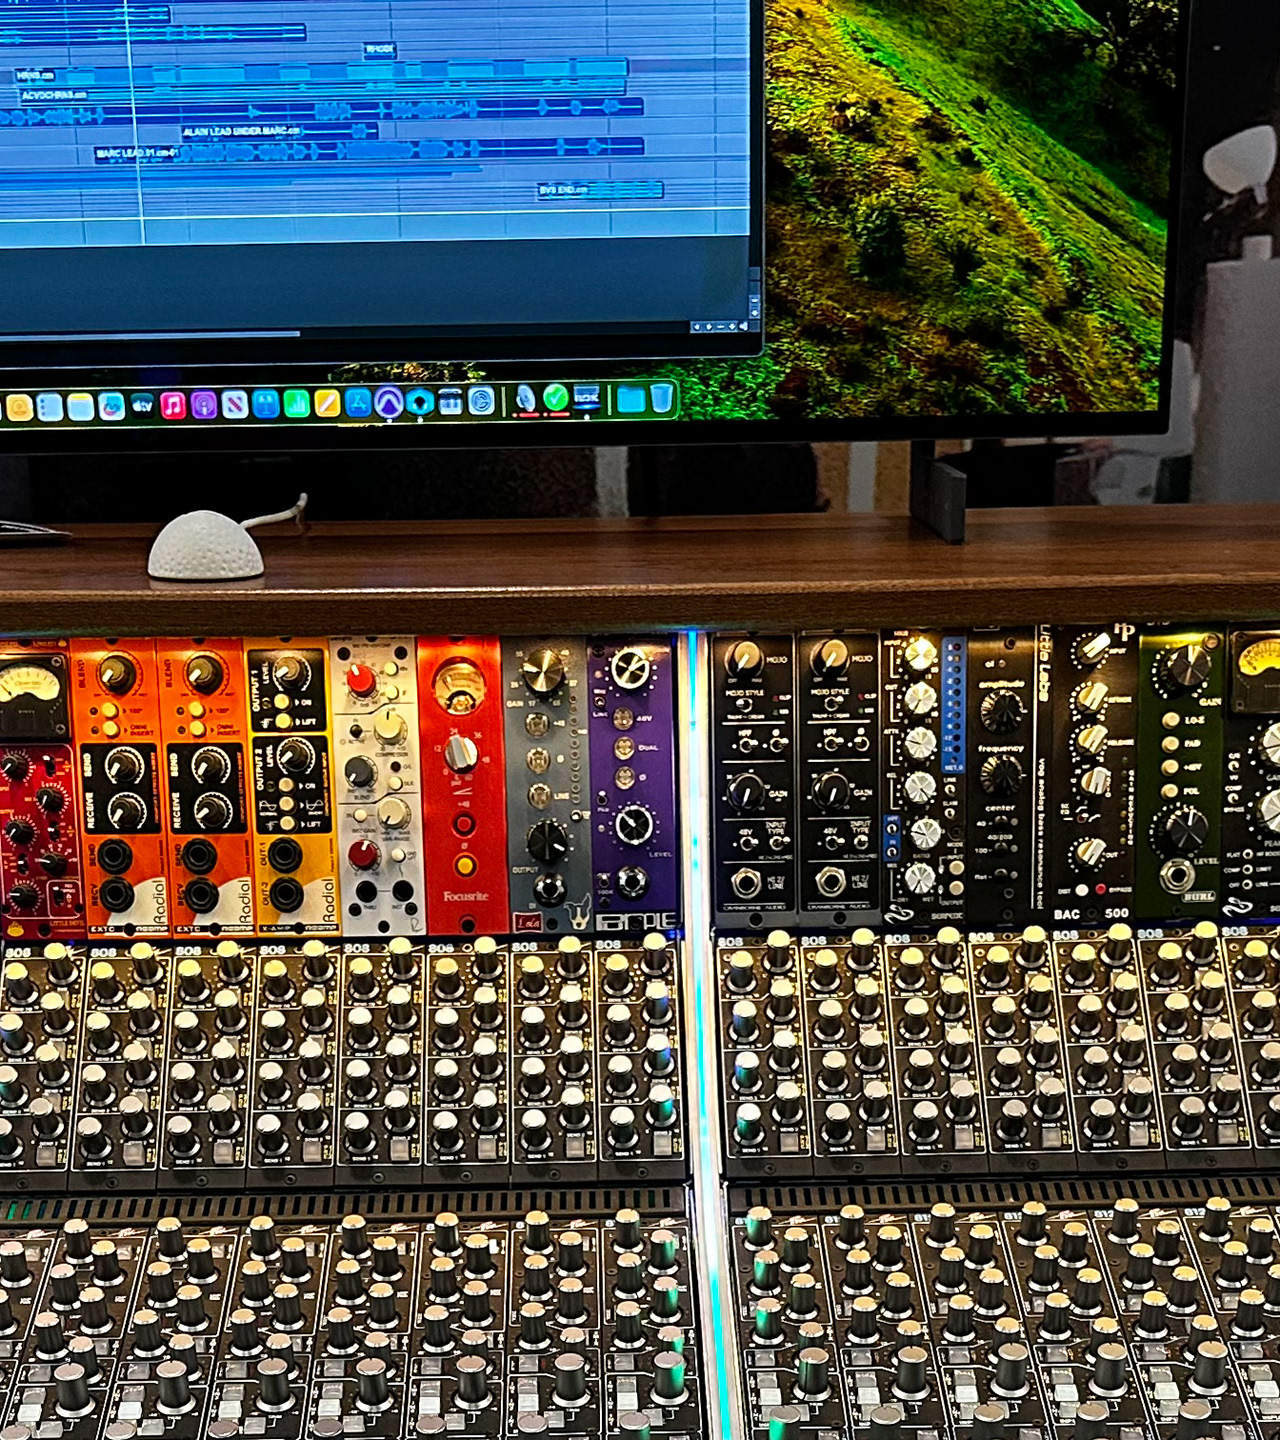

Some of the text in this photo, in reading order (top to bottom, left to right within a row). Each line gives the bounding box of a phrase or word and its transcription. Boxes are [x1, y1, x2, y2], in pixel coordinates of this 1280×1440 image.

[766, 656, 788, 664] MOJO
[851, 655, 874, 663] MOJO
[261, 661, 270, 685] LEVEL
[978, 680, 1025, 690] amplitude
[1039, 664, 1051, 702] Labs
[251, 681, 261, 713] OUTPUT
[725, 689, 744, 697] MOJO
[302, 717, 316, 726] LIFT
[978, 745, 1025, 754] frequency
[83, 753, 92, 778] SEND
[169, 753, 179, 778] SEND
[84, 791, 95, 830] RECEIVE
[172, 791, 181, 830] RECEIVE
[985, 804, 1016, 812] center
[765, 821, 787, 829] INPUT
[1194, 857, 1220, 865] LEVEL
[512, 866, 539, 874] OUTPUT
[321, 878, 335, 923] Radial
[443, 890, 489, 902] Focusrite
[1184, 892, 1215, 901] BURL
[153, 879, 167, 925] Radial
[238, 879, 252, 925] Radial
[1053, 908, 1129, 920] BAC 500
[91, 925, 116, 933] EXTC
[717, 937, 744, 947] 808
[5, 948, 32, 958] 808
